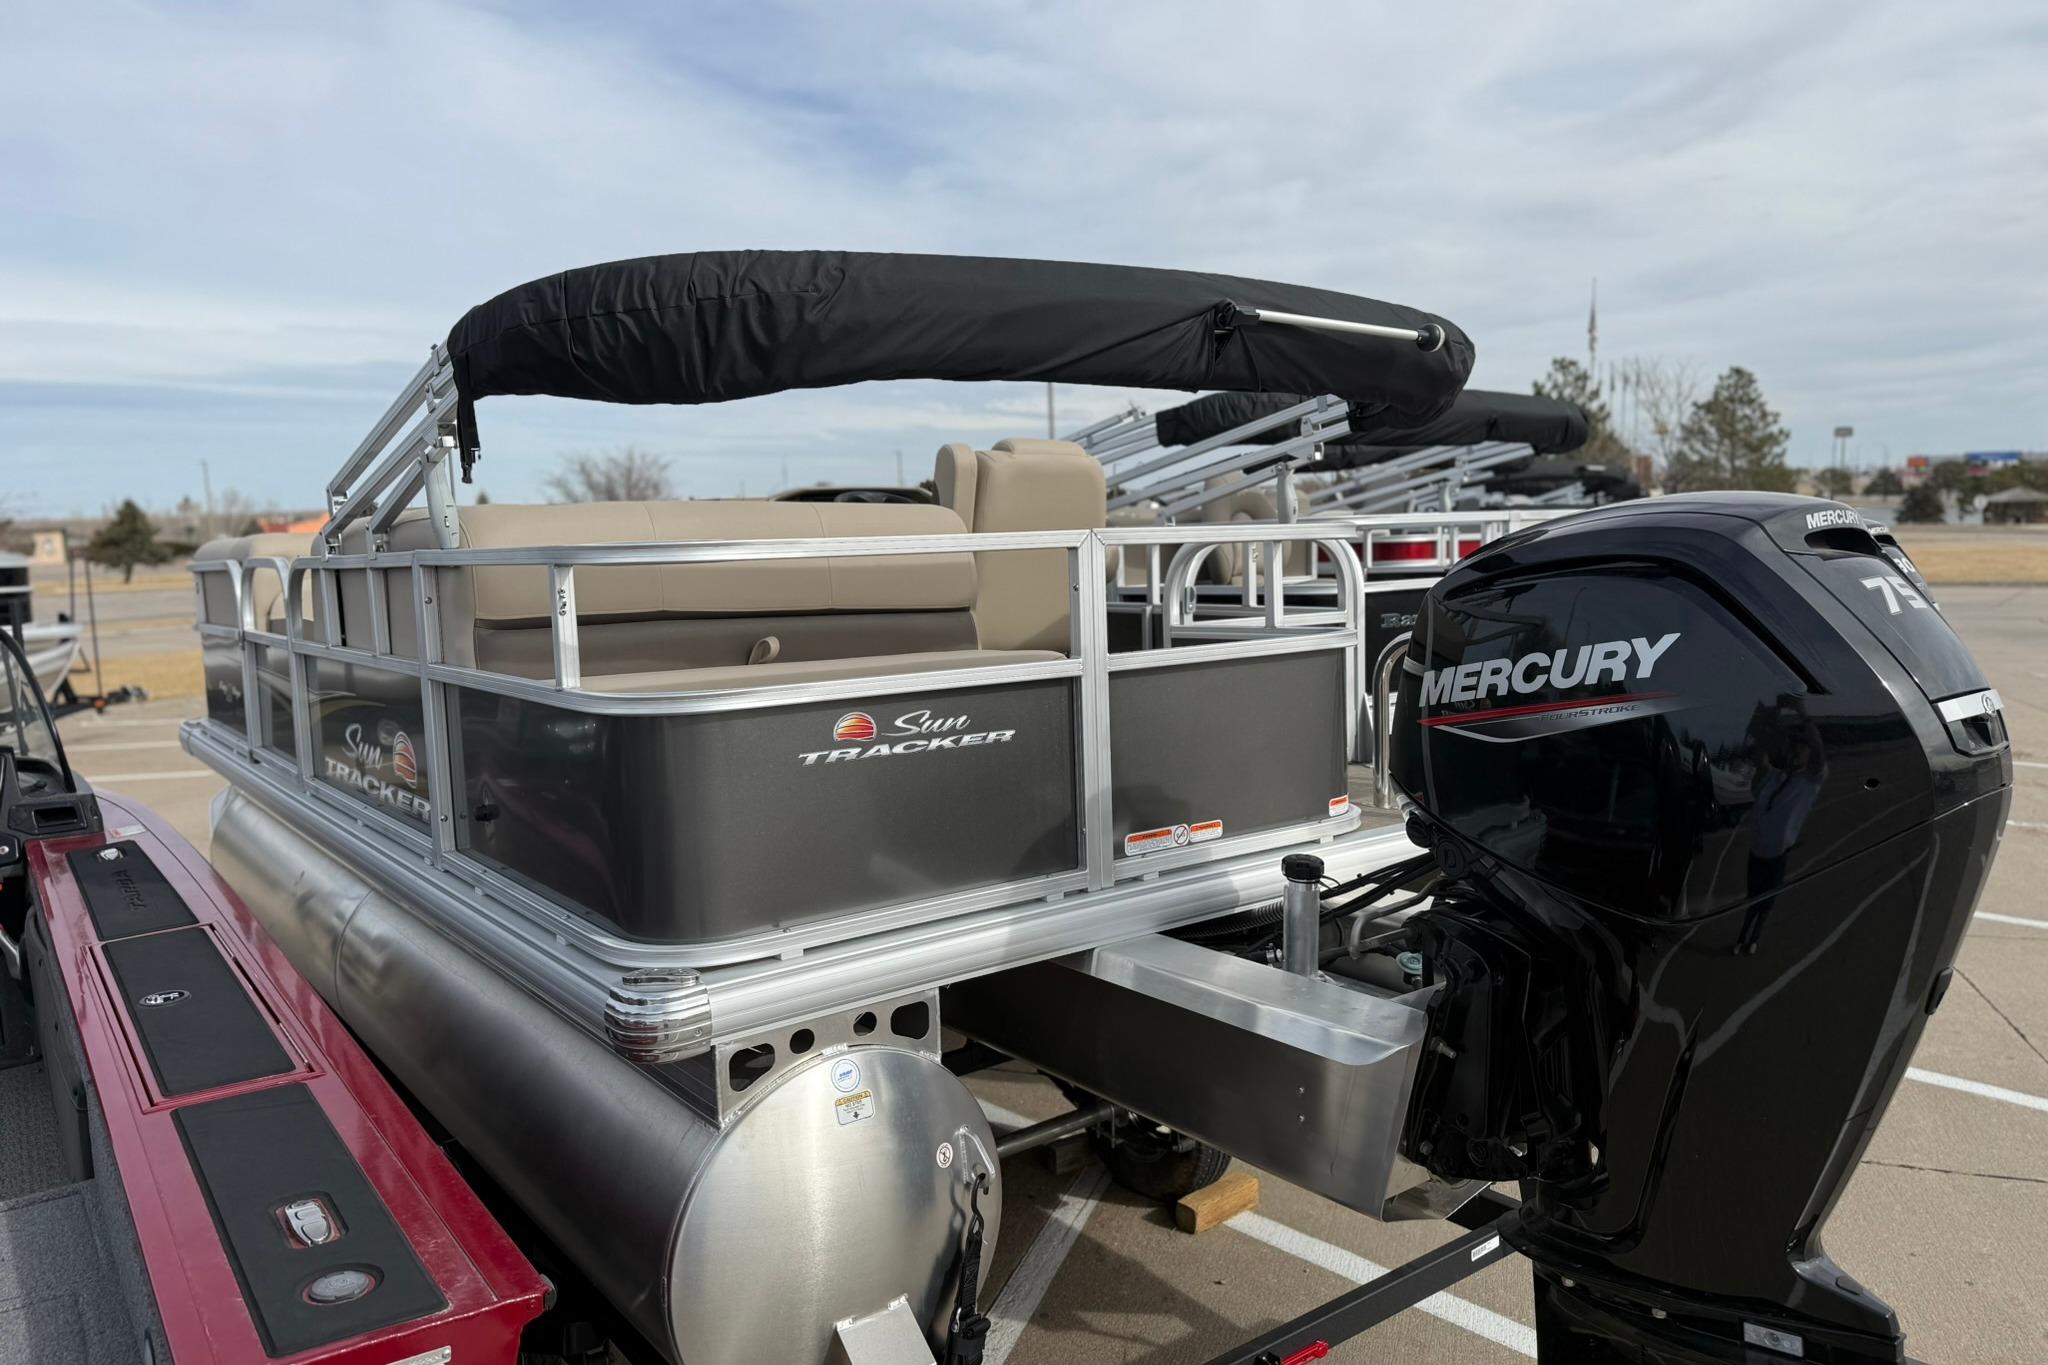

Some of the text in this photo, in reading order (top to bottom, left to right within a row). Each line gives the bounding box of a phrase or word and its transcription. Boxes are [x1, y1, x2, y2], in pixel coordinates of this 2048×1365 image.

[1806, 509, 1860, 529] MERCURY
[1859, 576, 1927, 615] 75
[1418, 633, 1681, 707] MERCURY
[881, 709, 971, 736] Sun
[1538, 704, 1641, 721] FOURSTROKE
[342, 723, 383, 770] Sun
[798, 729, 1016, 767] TRACKER
[325, 755, 431, 820] TRACKER
